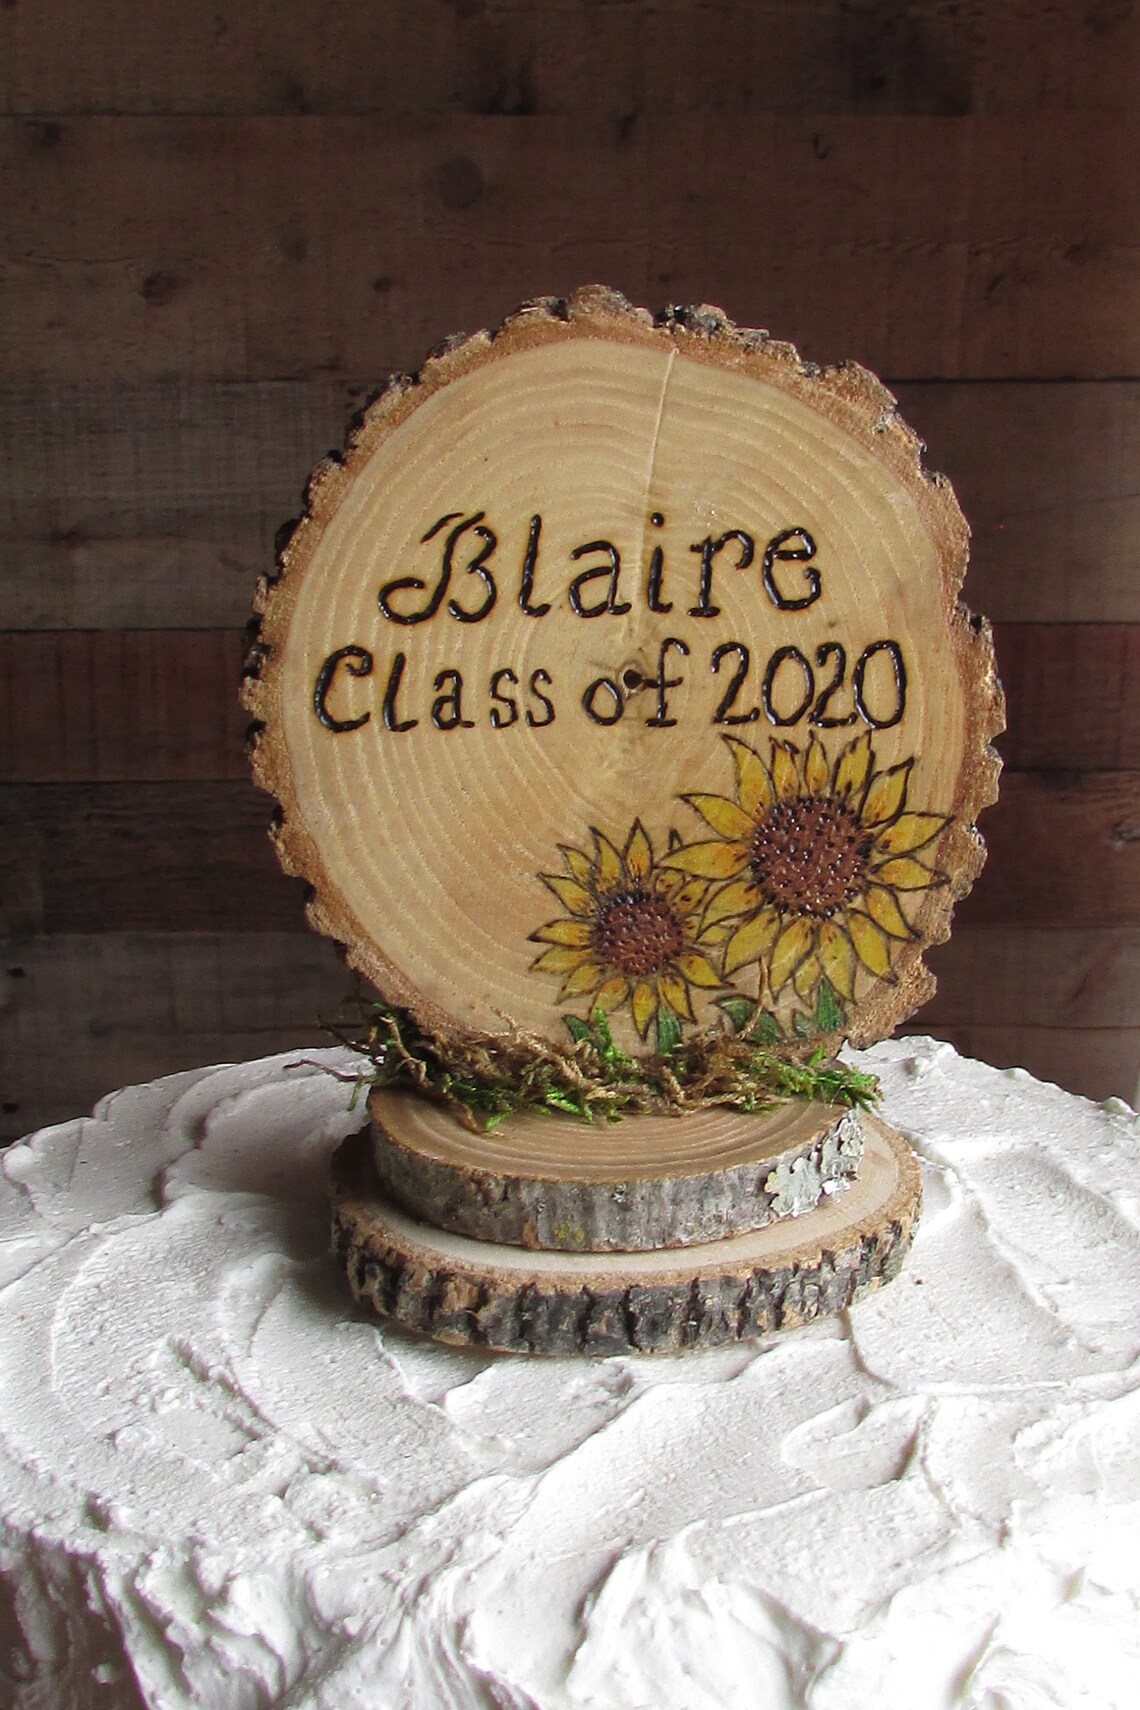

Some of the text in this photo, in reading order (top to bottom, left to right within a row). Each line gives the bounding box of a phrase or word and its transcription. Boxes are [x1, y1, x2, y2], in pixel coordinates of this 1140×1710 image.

[377, 510, 823, 626] Blaire
[312, 636, 909, 734] Class of 2020
